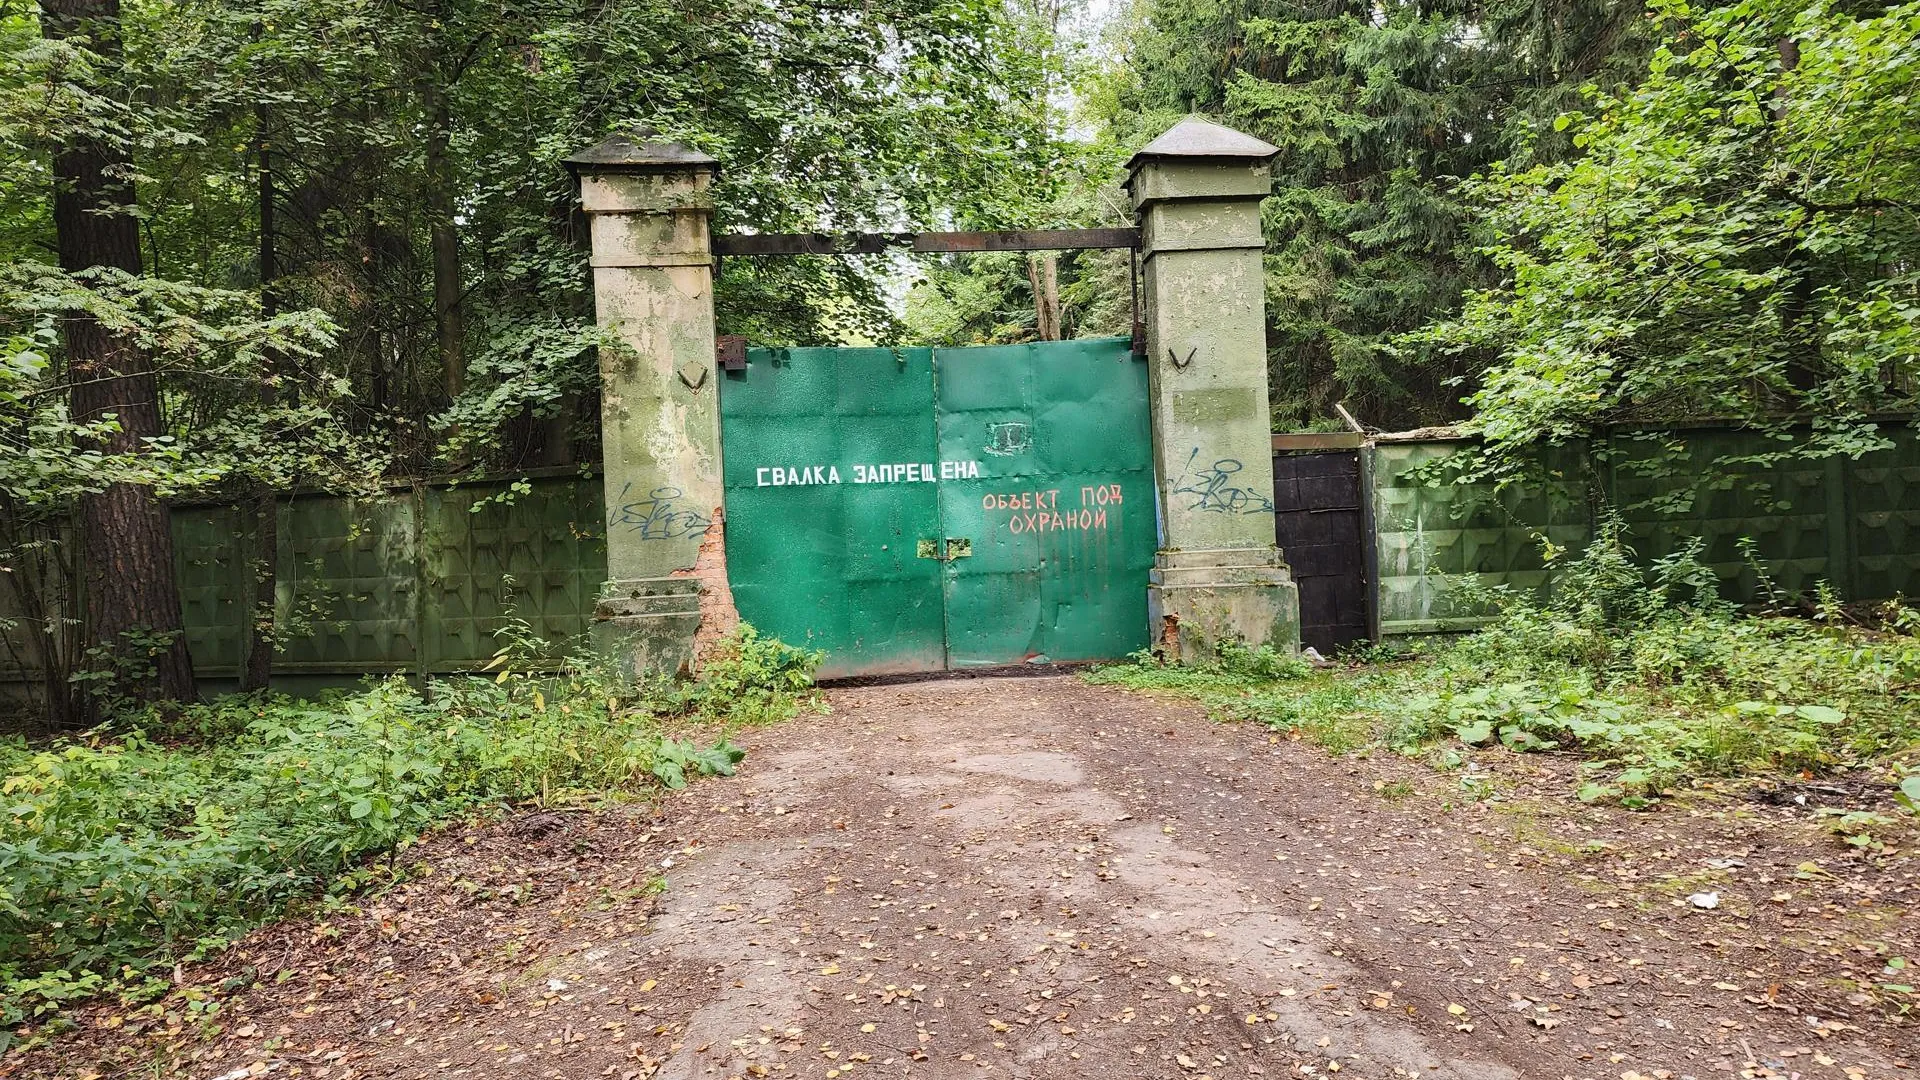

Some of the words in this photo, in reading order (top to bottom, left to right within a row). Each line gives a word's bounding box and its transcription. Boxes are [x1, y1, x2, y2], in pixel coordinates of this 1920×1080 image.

[756, 466, 841, 486] СВАЛКА
[982, 489, 1060, 510] ОБЪЕКТ
[1082, 484, 1123, 506] ПОД
[1009, 508, 1107, 534] ОХРАНОЙ
